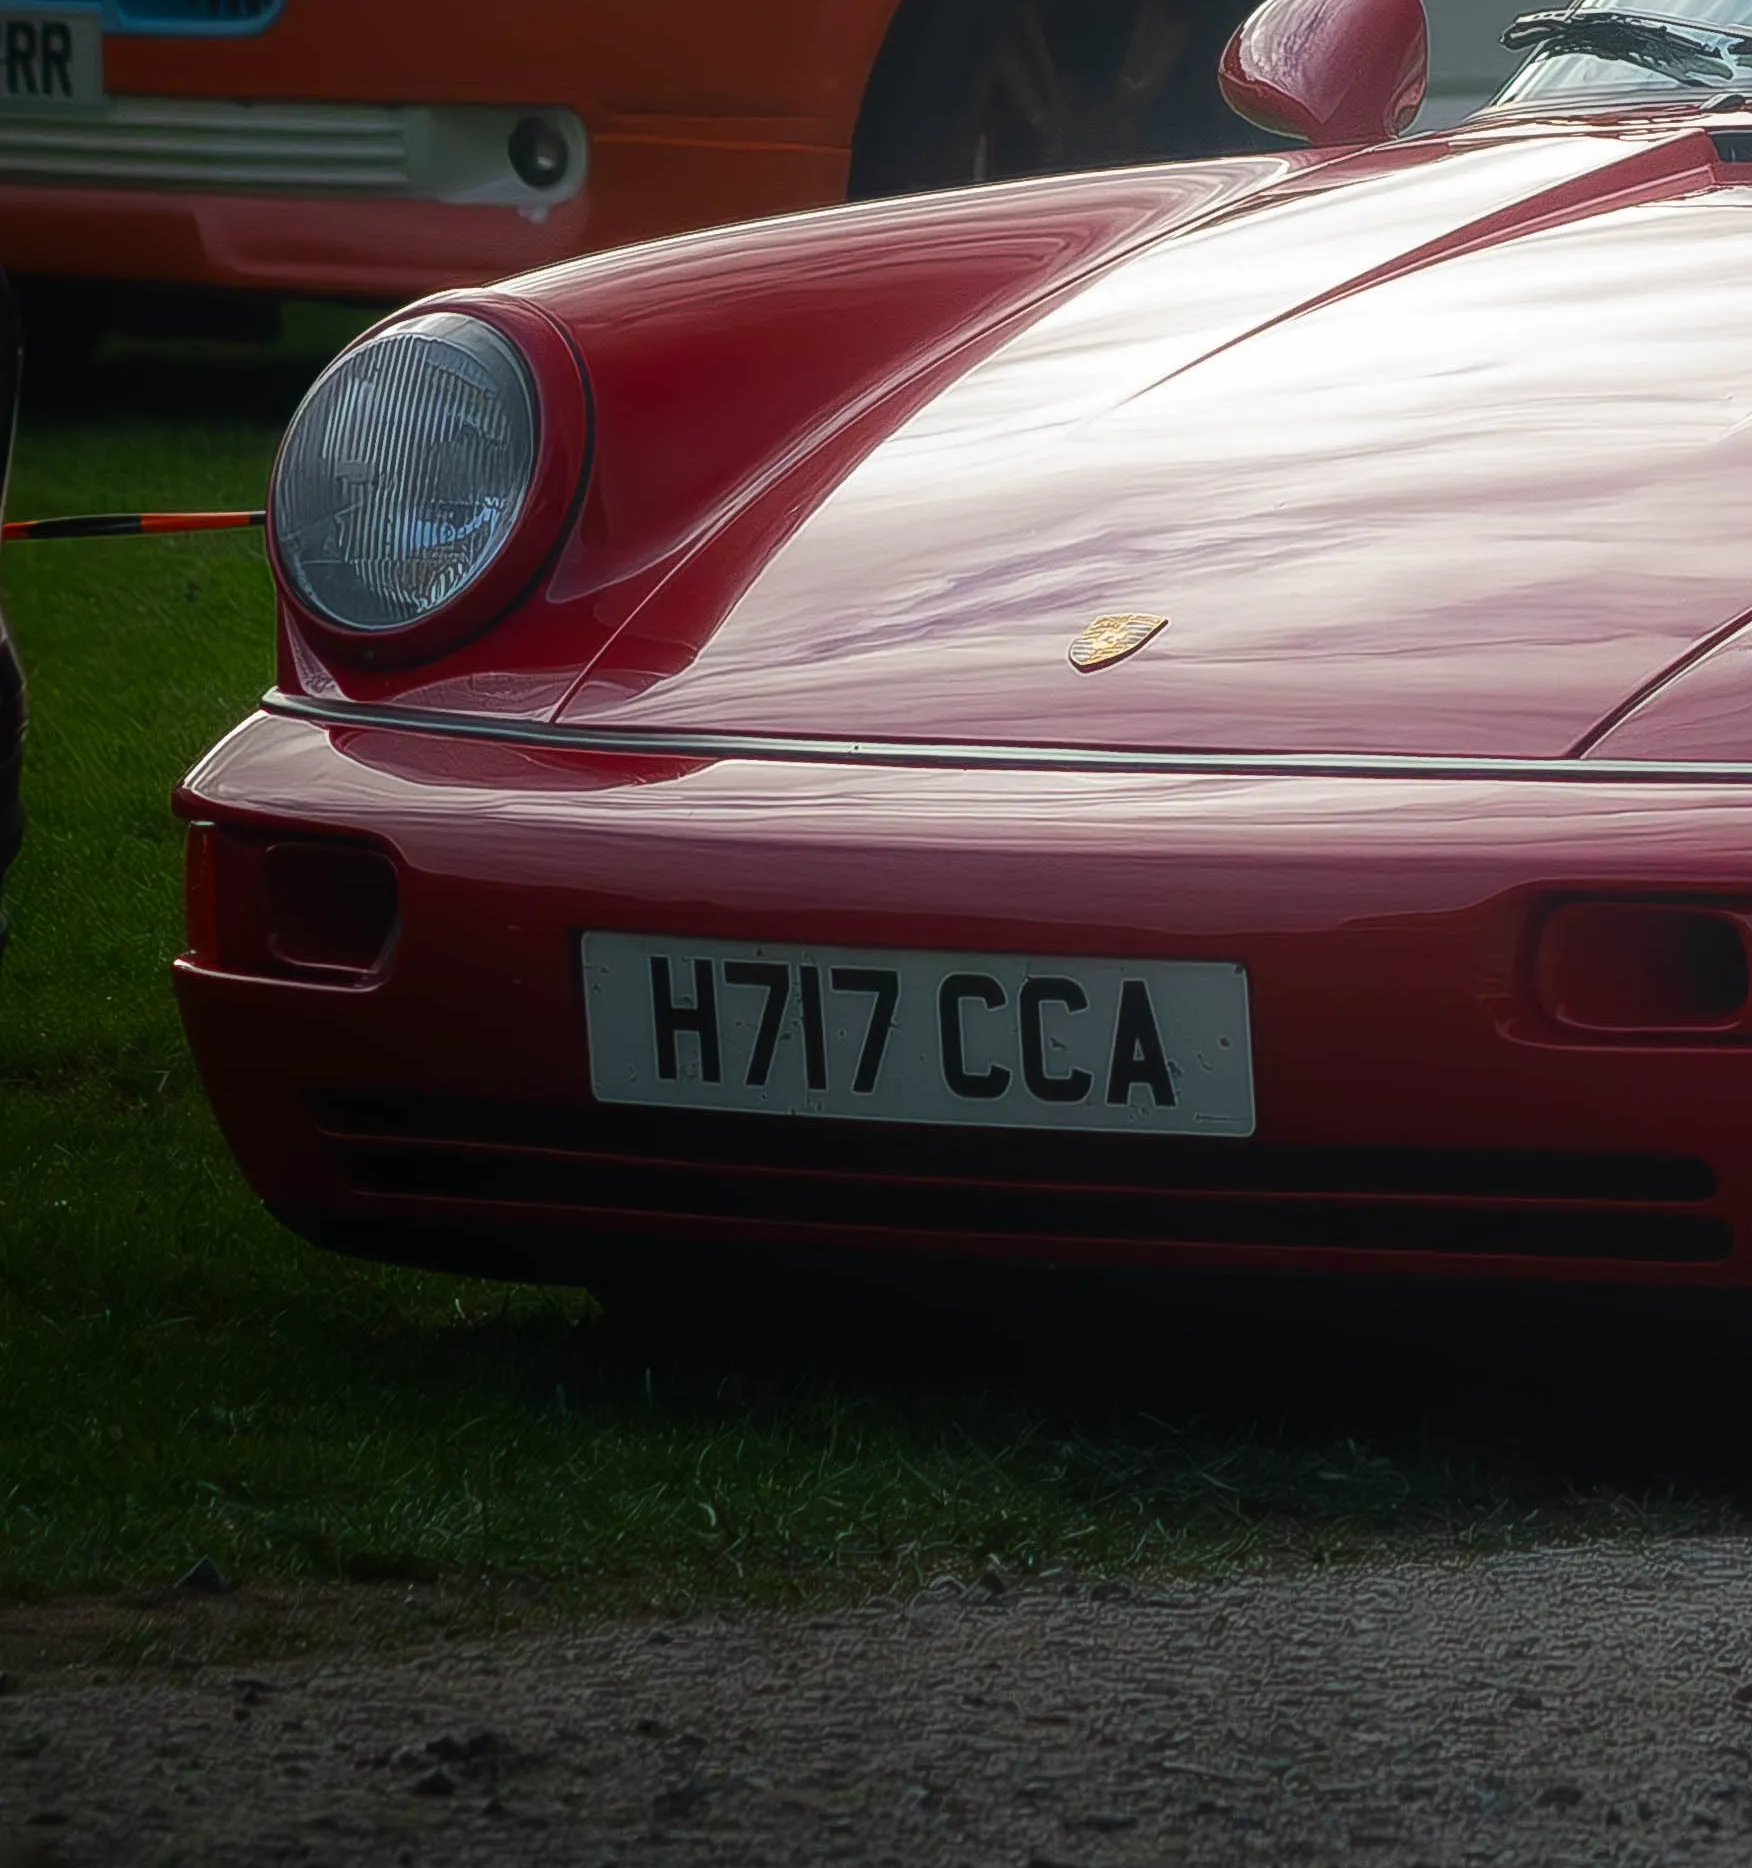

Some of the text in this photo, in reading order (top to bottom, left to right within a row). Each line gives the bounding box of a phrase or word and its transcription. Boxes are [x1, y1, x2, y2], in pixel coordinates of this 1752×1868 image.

[0, 20, 73, 97] RR
[648, 955, 1177, 1107] H717 CCA
